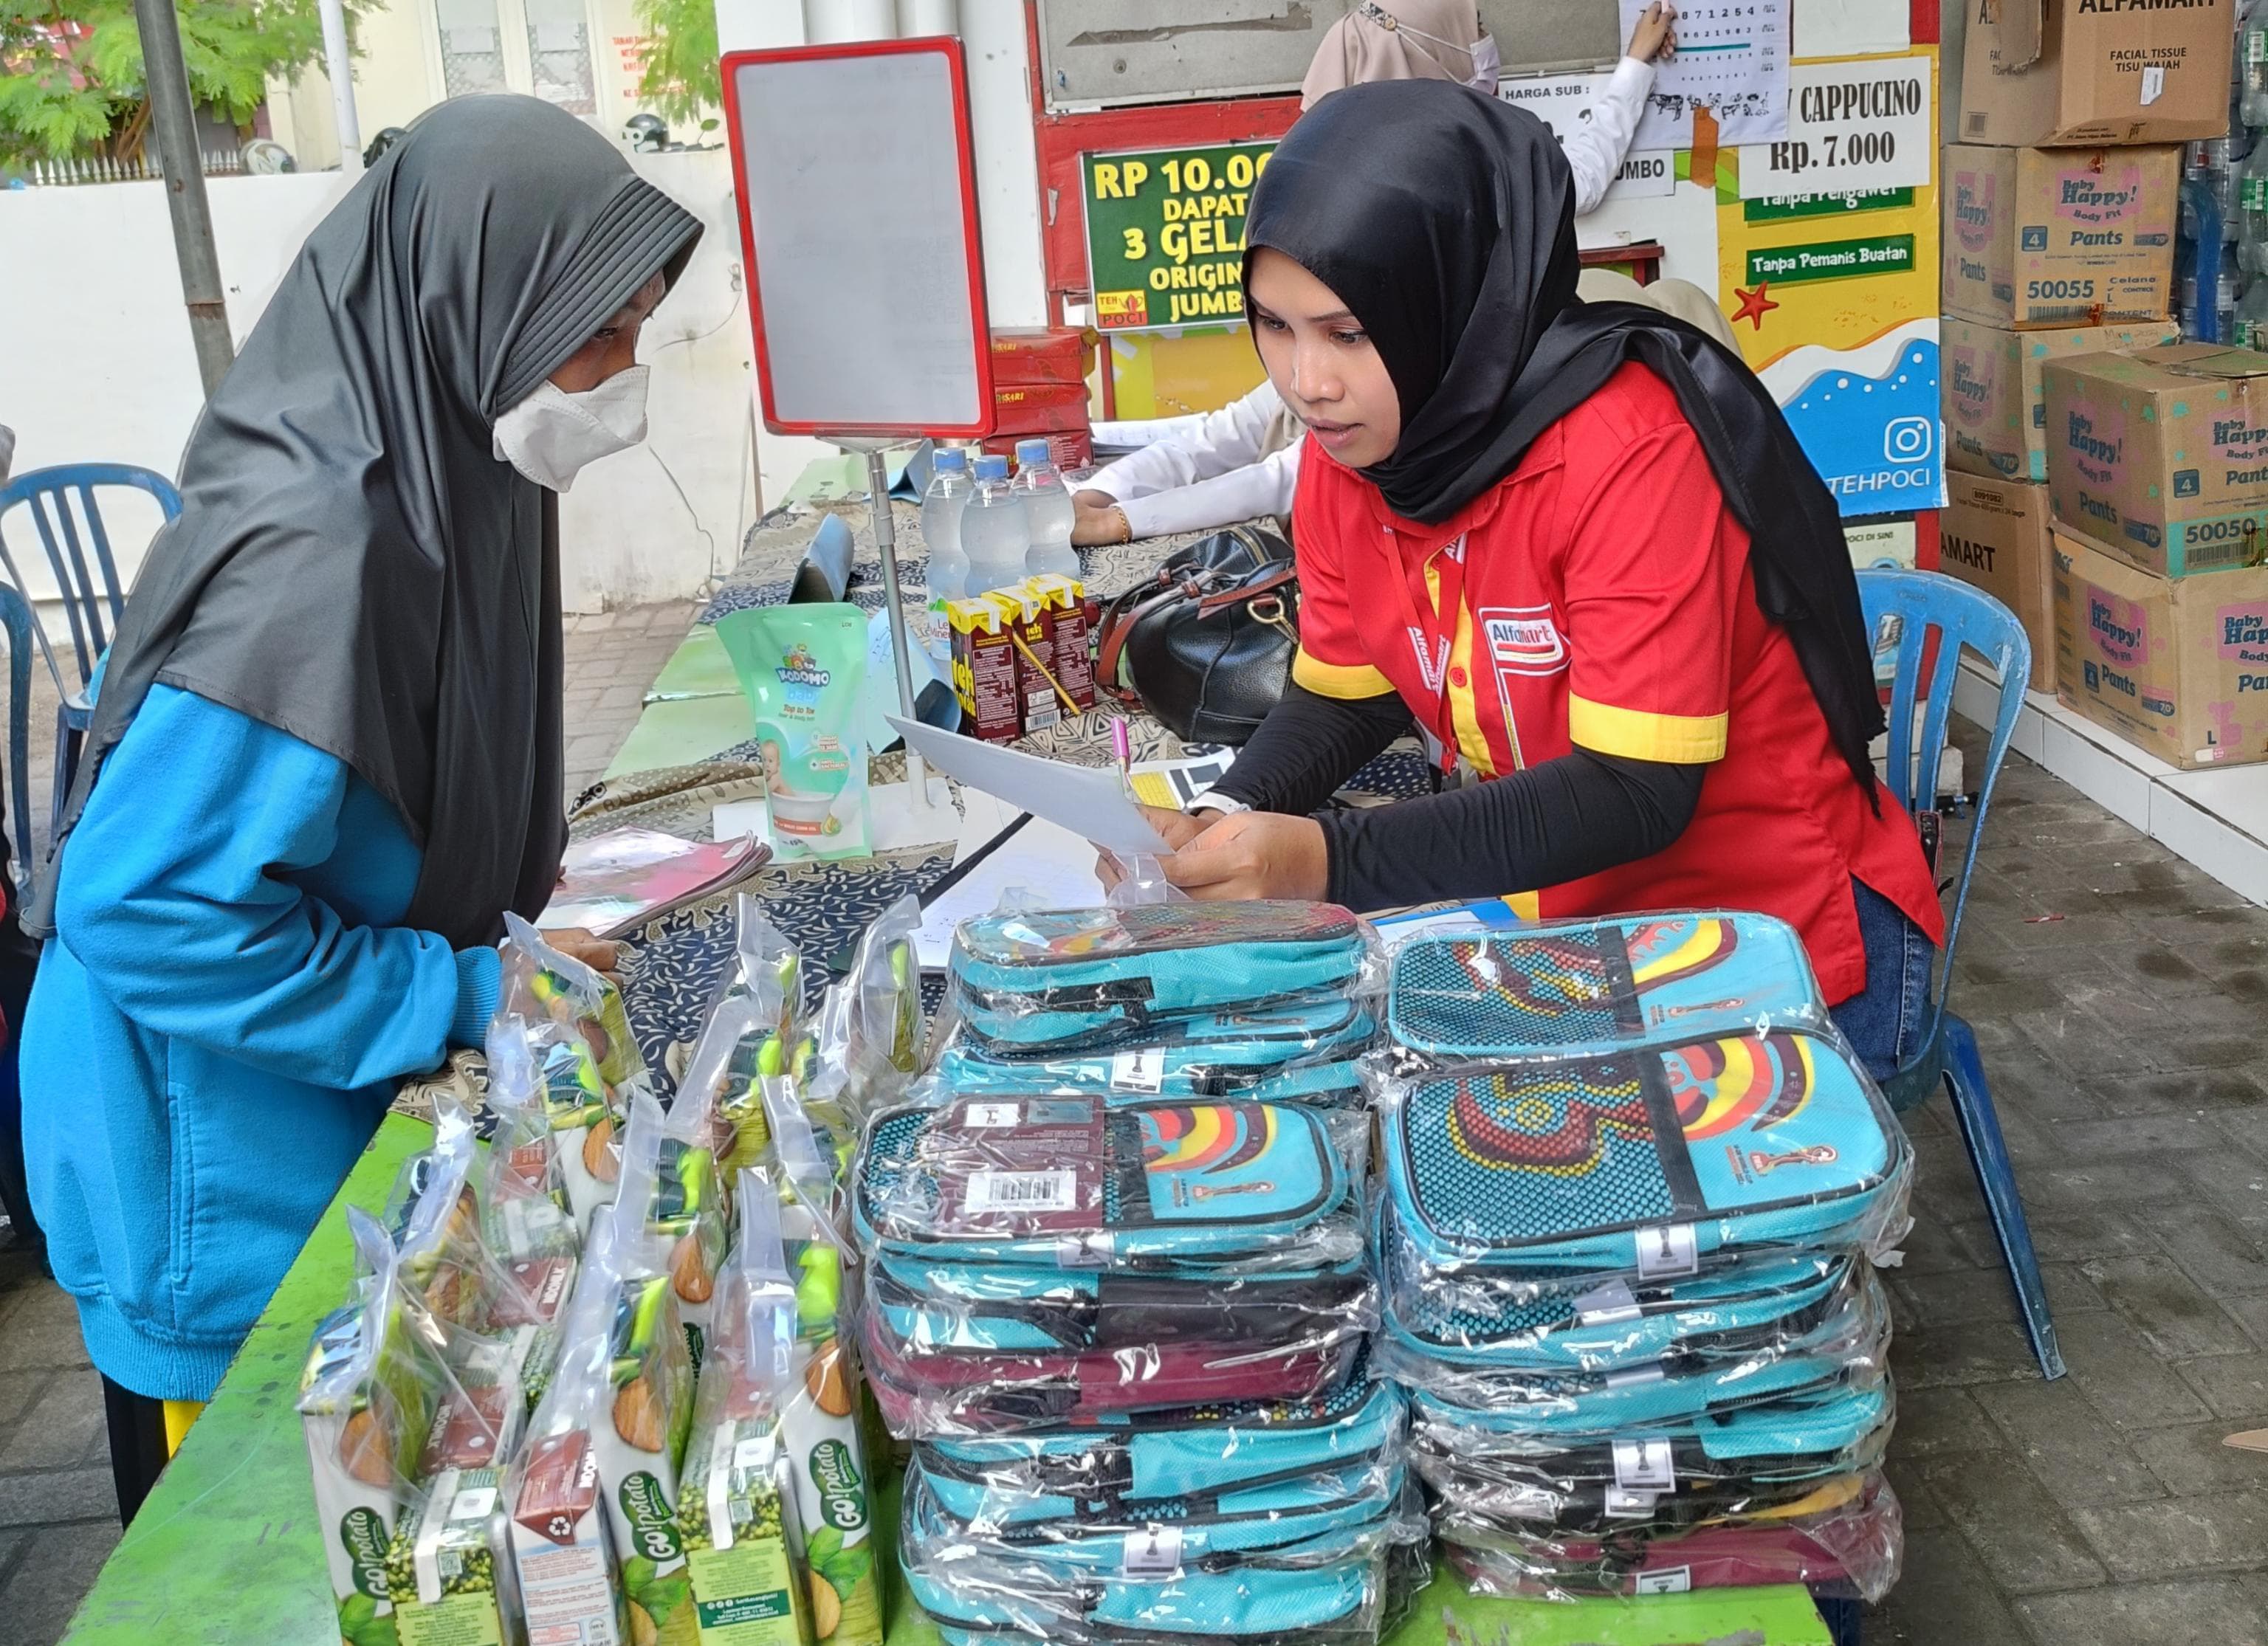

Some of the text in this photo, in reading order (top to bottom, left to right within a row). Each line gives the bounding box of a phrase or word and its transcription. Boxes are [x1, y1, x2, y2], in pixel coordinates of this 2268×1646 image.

[2110, 47, 2187, 61] FACIAL TISSUE
[2115, 62, 2139, 72] TISU
[1505, 88, 1551, 100] HARGA
[1555, 85, 1582, 97] SUB
[1801, 78, 1921, 123] CAPPUCINO
[1770, 131, 1895, 173] Rp. 7.000
[1093, 161, 1148, 200] RP
[2062, 179, 2096, 192] Baby
[2061, 186, 2137, 207] Happy!
[1163, 193, 1248, 221] DAPAT
[2073, 209, 2122, 222] Body Fit
[1123, 227, 1147, 260] 3
[2029, 233, 2040, 246] 4
[2070, 230, 2124, 247] Pants
[1752, 246, 1907, 275] Tanpa Pemanis Buatan
[1960, 257, 1986, 282] Pants
[2027, 280, 2095, 299] 50055
[1099, 296, 1118, 306] TEH
[1102, 312, 1144, 326] POCI
[2213, 419, 2246, 433] Baby
[2226, 449, 2255, 460] Body
[2225, 466, 2268, 486] Pant
[2181, 478, 2192, 492] 4
[2078, 490, 2117, 524] Pants
[2186, 518, 2256, 544] 50050
[2092, 597, 2112, 620] Baby
[938, 618, 949, 630] Le
[2224, 614, 2263, 628] Baby
[2224, 627, 2268, 645] Hap
[778, 669, 830, 686] KODOMO
[2088, 672, 2095, 683] 4
[2101, 664, 2136, 698] Pants
[2207, 730, 2217, 745] L
